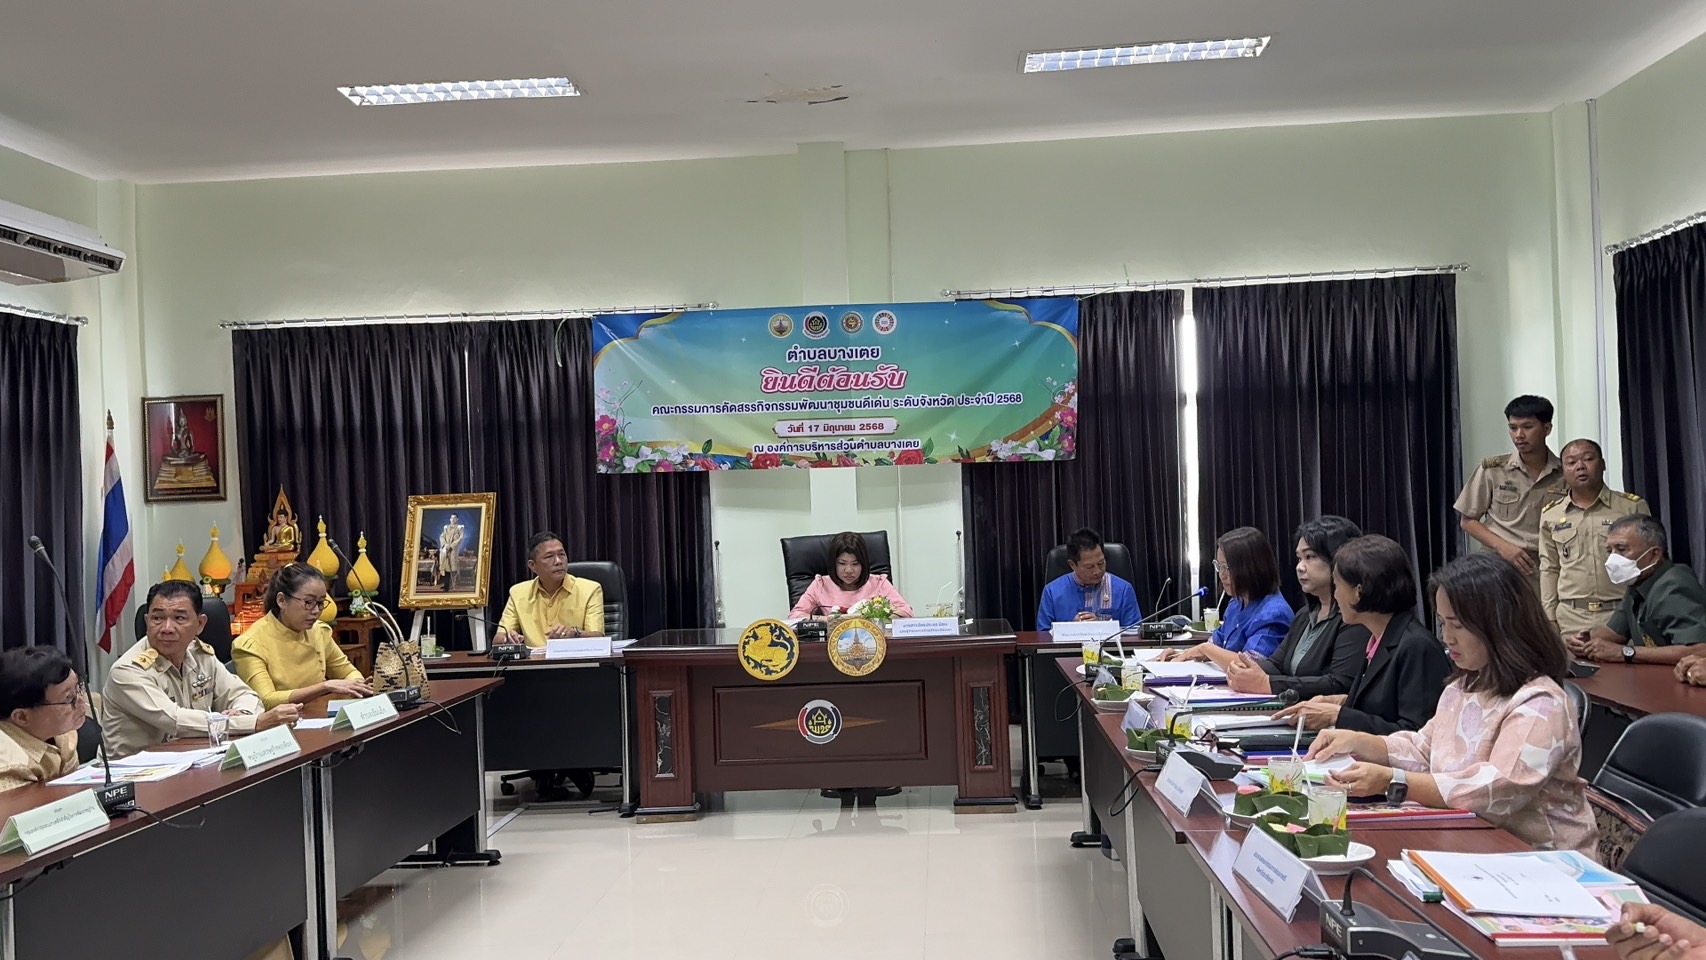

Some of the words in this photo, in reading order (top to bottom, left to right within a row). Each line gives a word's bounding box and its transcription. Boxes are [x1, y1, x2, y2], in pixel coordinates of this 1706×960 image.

[787, 345, 880, 361] ตำบลบางเตย
[760, 364, 907, 392] ยินดีต้อนรับ
[652, 396, 890, 414] คณะกรรมการคัดสรรกิจกรรมพัฒนาชุมชนดีเด่น
[893, 394, 955, 408] ระดับจังหวัด
[957, 393, 995, 406] ประจำปี
[997, 393, 1022, 404] 2568
[787, 422, 804, 433] วันที่
[808, 424, 820, 432] 17
[823, 422, 856, 434] มิถุนายน
[859, 422, 885, 431] 2568
[754, 444, 764, 453] ณ
[768, 439, 920, 453] องค์การบริหารส่วนตำบลบางเตย
[105, 786, 128, 799] NPE
[1325, 912, 1343, 938] NPE
